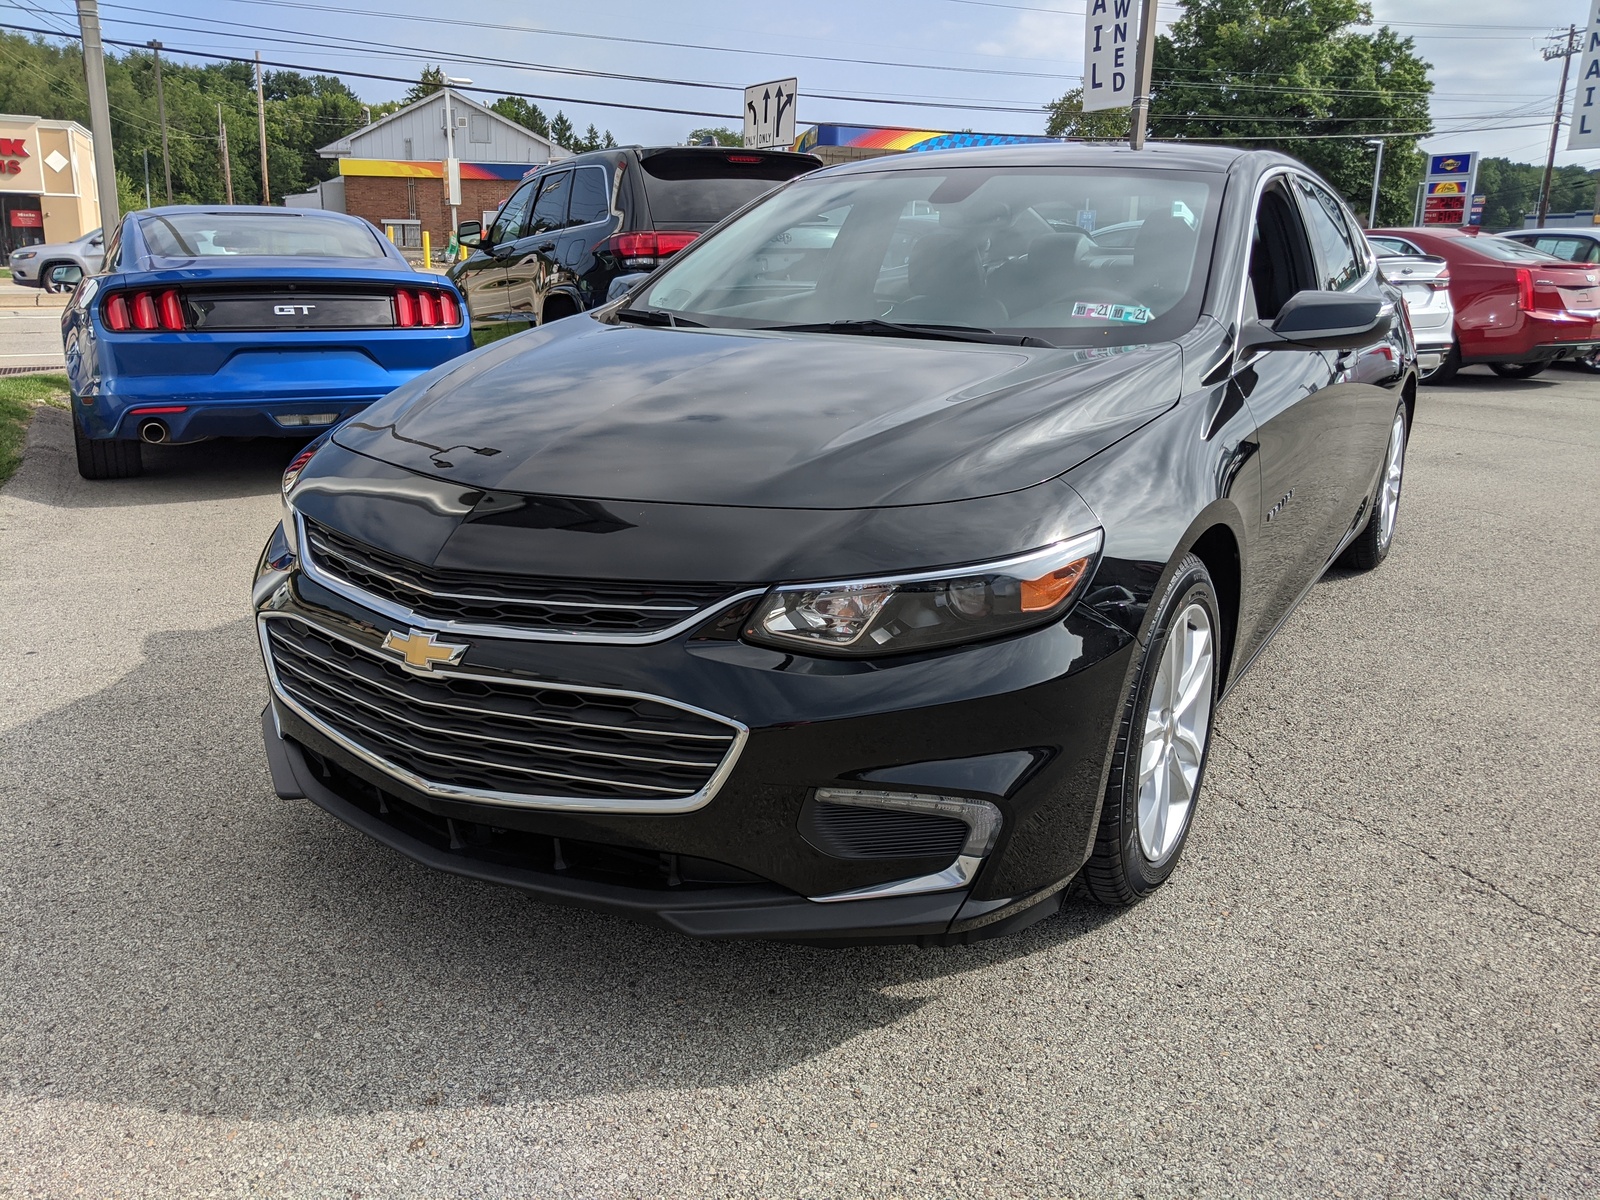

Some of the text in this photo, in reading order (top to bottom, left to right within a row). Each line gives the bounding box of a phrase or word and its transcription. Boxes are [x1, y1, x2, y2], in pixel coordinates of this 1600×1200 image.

[759, 133, 771, 144] ONLY
[274, 305, 316, 315] GT
[1097, 304, 1109, 316] 21
[1135, 308, 1147, 321] 21
